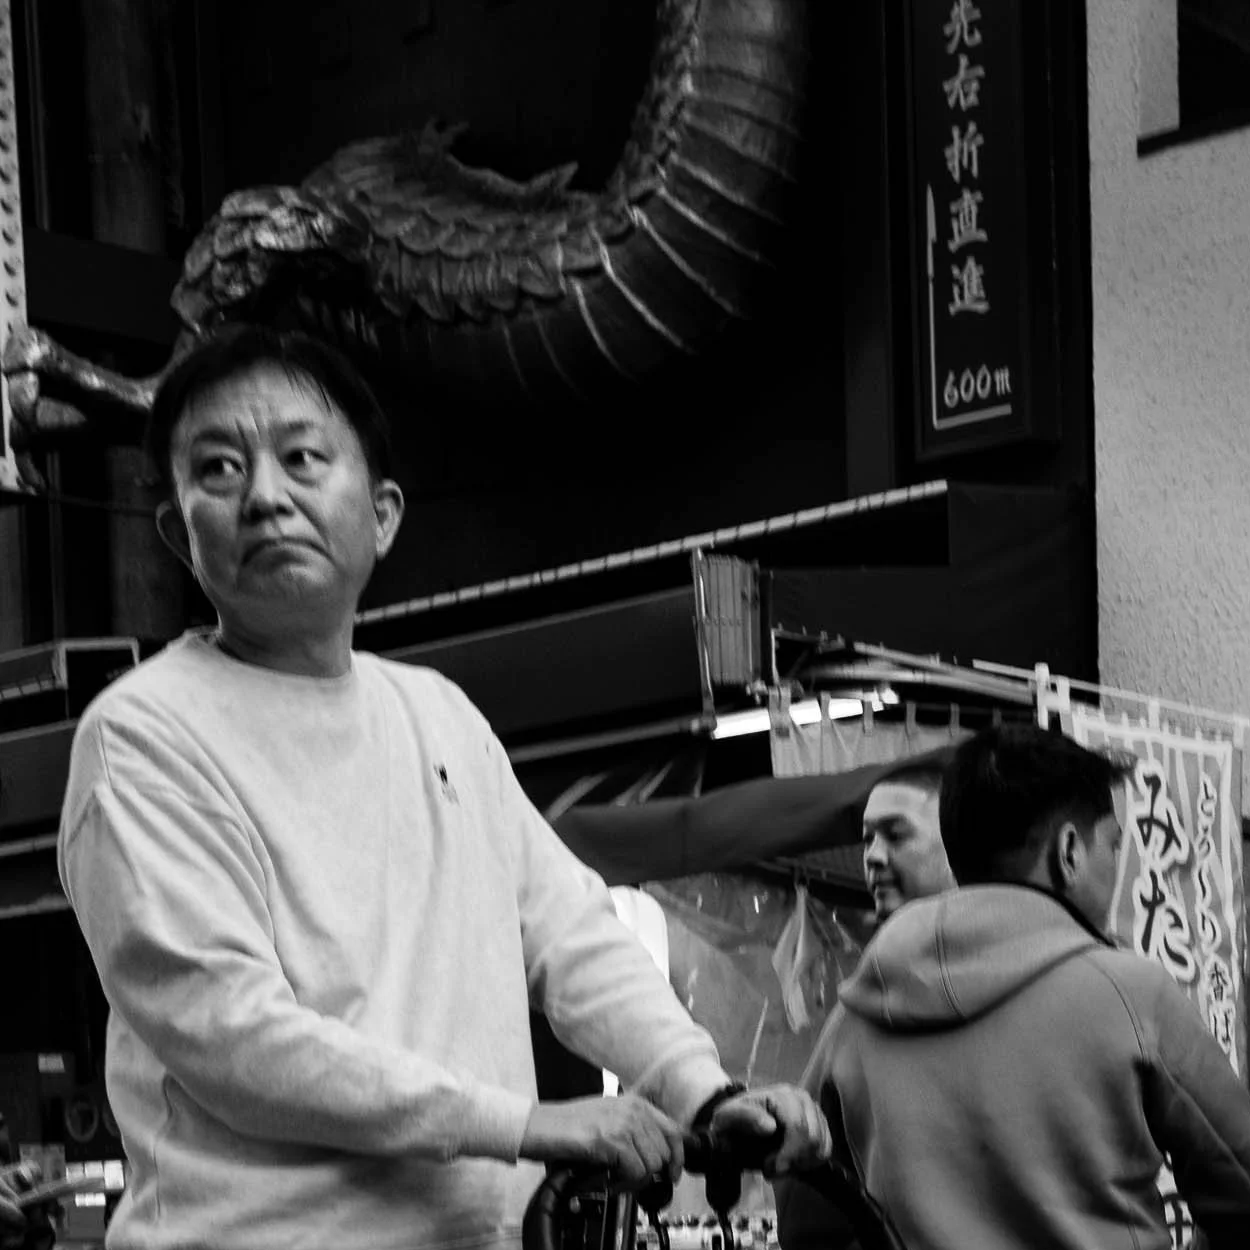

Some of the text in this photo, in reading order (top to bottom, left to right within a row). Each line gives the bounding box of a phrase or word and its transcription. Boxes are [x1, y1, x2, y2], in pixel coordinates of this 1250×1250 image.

[942, 0, 990, 317] 先右折直進
[943, 364, 1012, 408] 600m
[1132, 768, 1193, 970] みた
